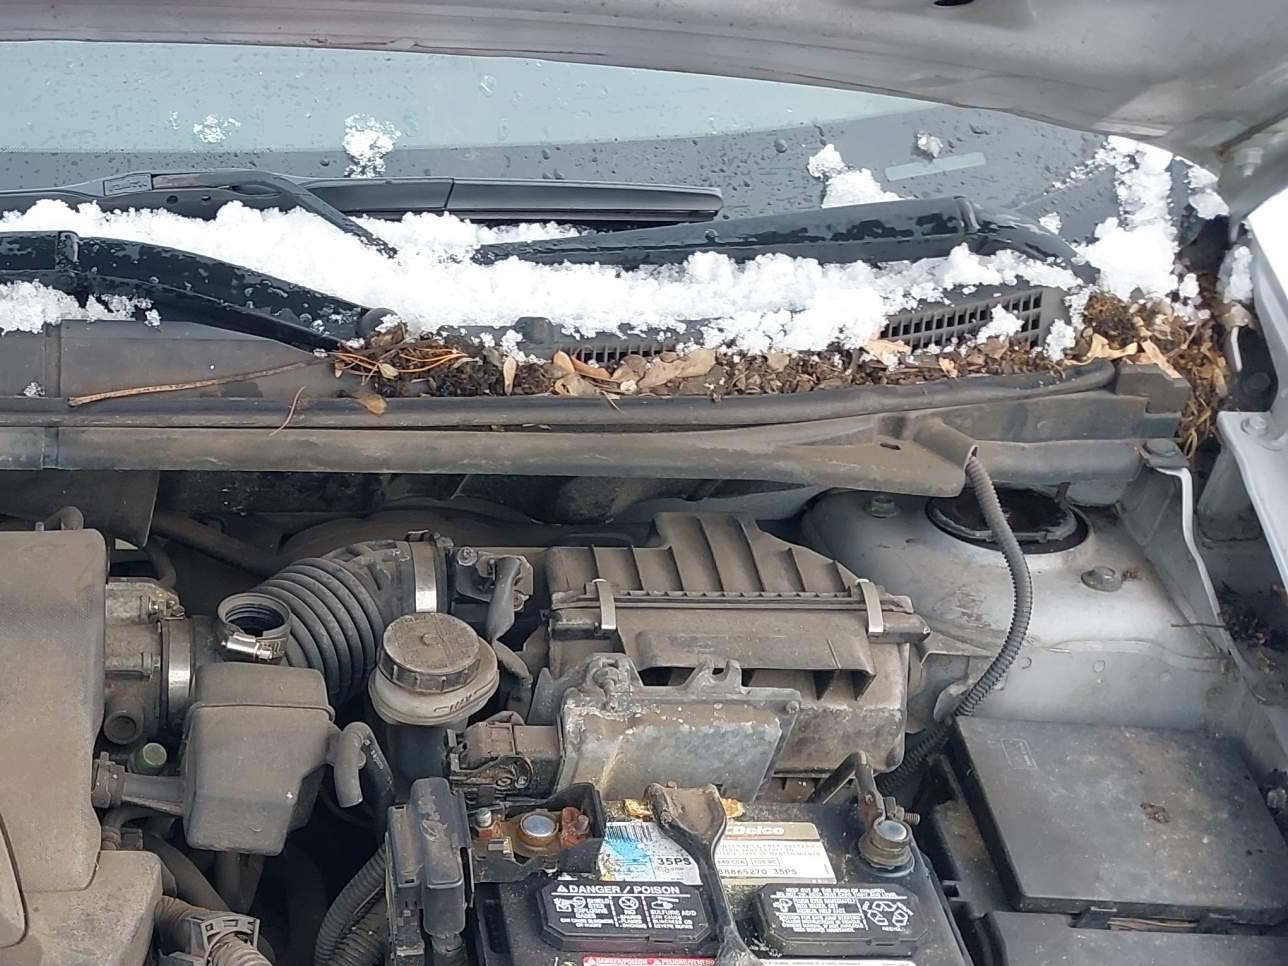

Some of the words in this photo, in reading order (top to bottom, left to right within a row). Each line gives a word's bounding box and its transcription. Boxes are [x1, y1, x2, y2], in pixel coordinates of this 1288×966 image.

[657, 857, 692, 866] 35PS
[569, 885, 621, 894] DANGER
[634, 886, 680, 894] POISON
